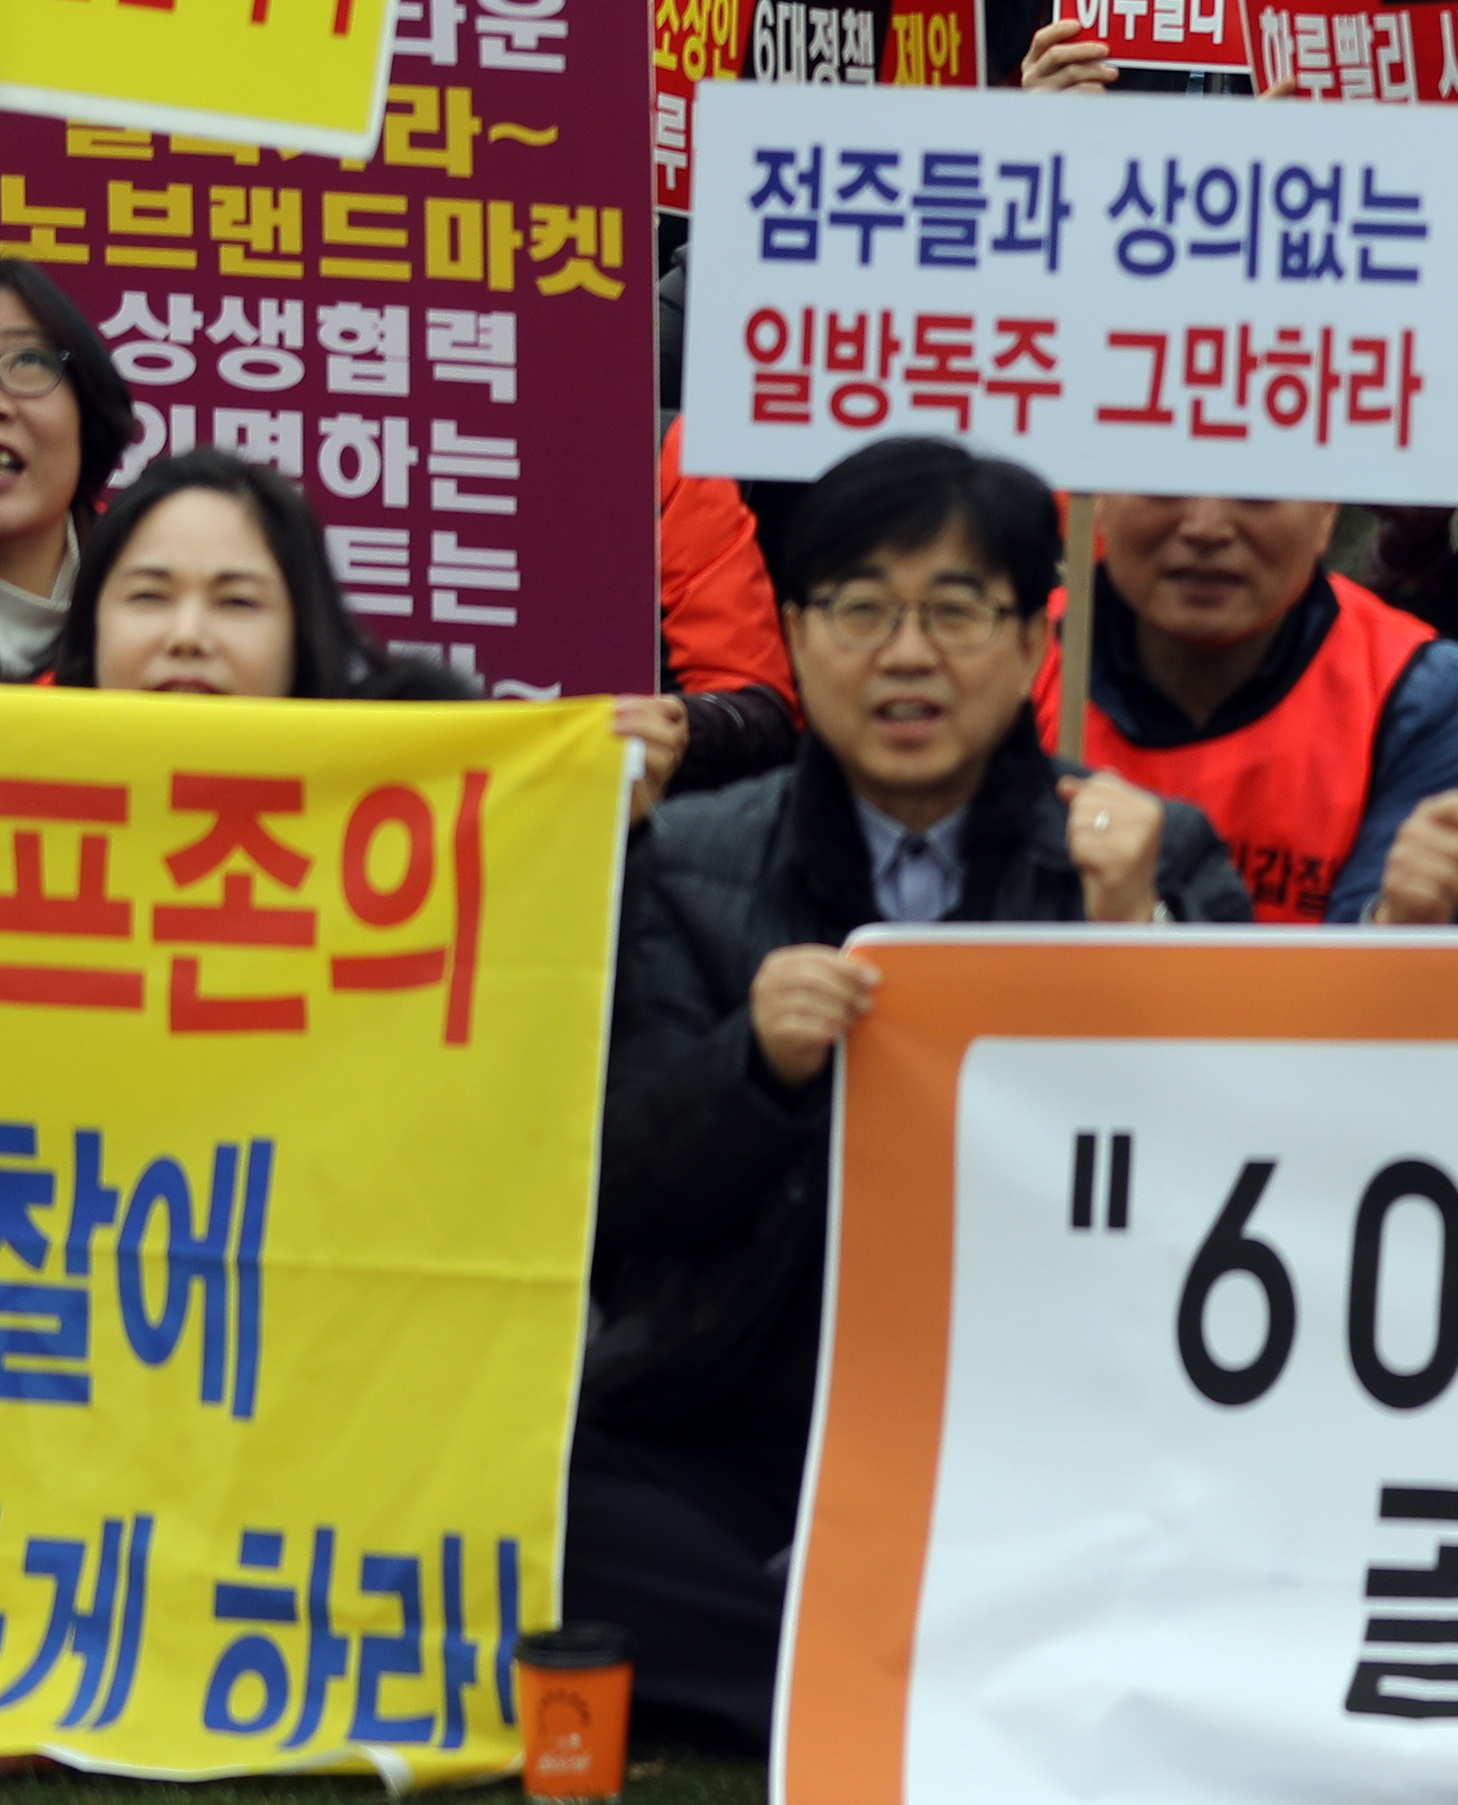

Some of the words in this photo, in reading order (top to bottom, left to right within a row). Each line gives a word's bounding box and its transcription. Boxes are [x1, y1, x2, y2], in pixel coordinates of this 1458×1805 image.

[0, 175, 626, 299] 노브랜드마켓
[749, 143, 1071, 272] 점주들과
[1108, 156, 1430, 284] 상의없는
[100, 291, 519, 403] 상생협력
[743, 307, 1064, 436] 일방독주
[1094, 323, 1423, 450] 그만하라
[202, 1525, 520, 1751] 하라!
